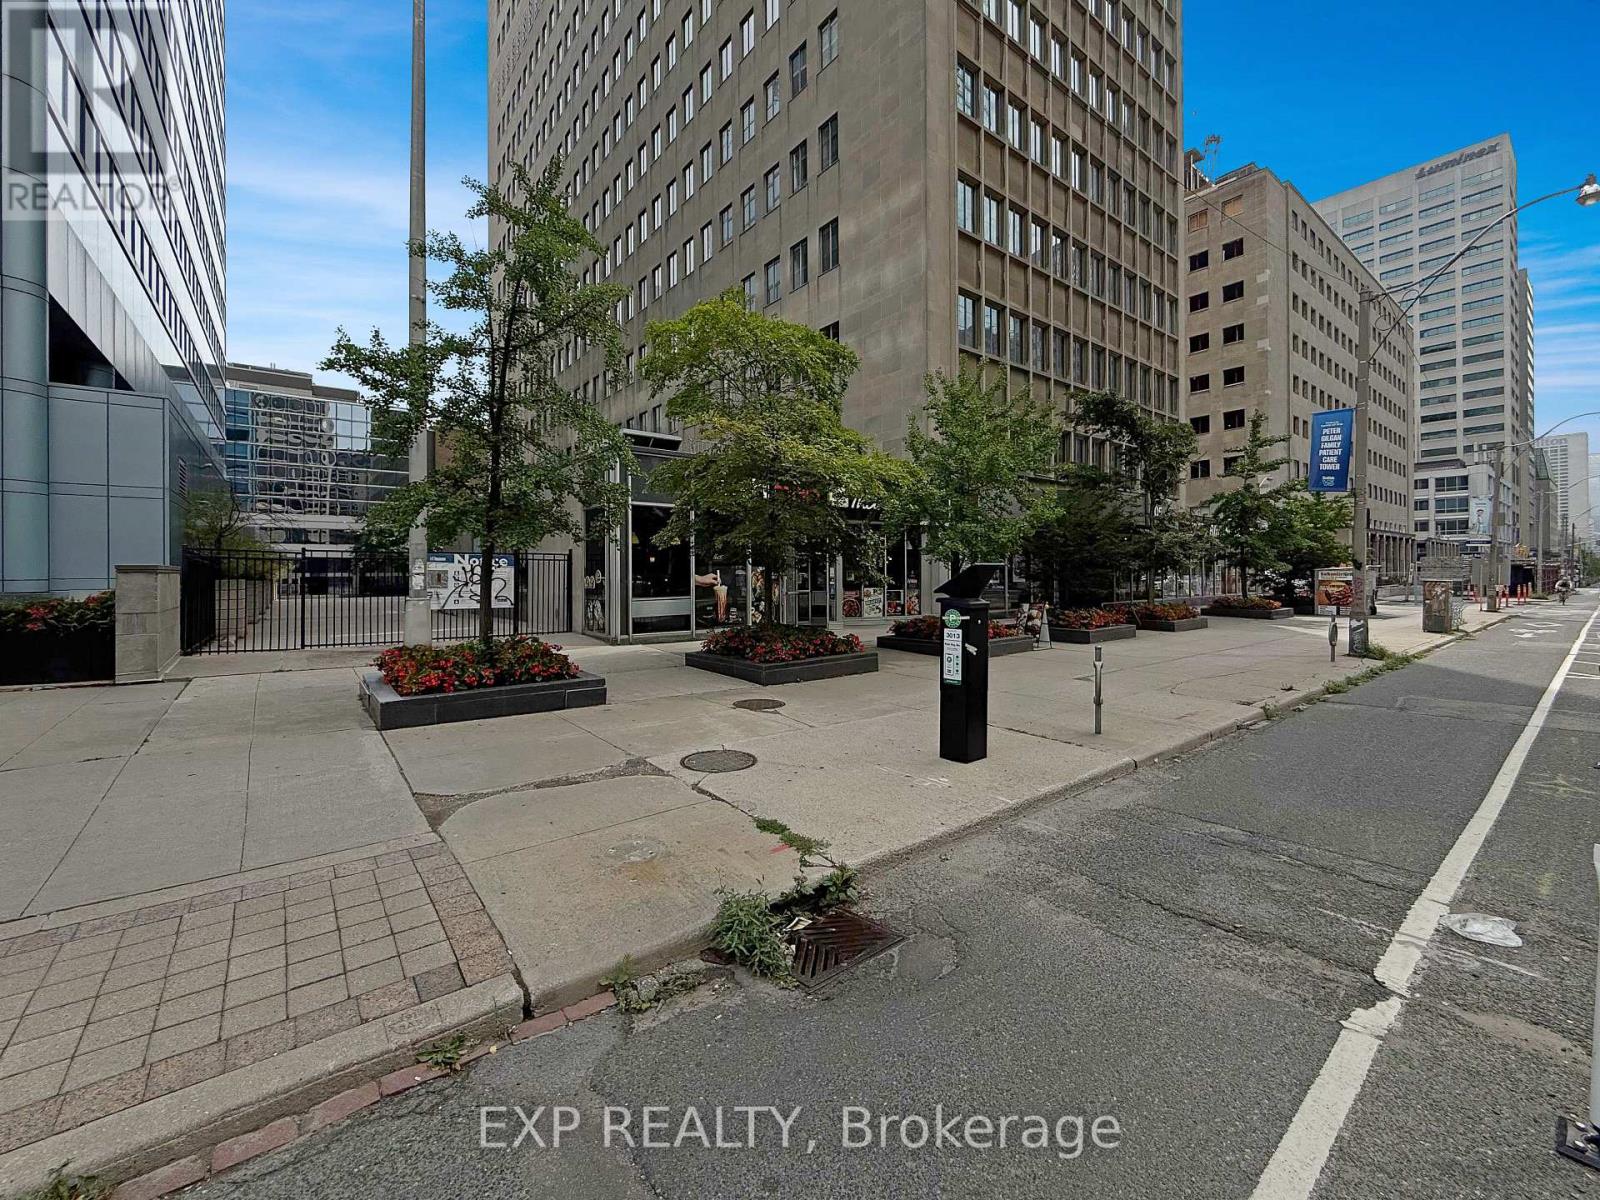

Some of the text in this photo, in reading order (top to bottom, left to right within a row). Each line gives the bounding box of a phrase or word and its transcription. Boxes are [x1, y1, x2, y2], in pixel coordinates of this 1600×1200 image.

[1322, 427, 1341, 435] PETER
[1320, 441, 1342, 449] FAMILY
[1319, 448, 1343, 456] PATIENT
[1319, 463, 1340, 471] TOWER
[454, 553, 508, 567] Noce
